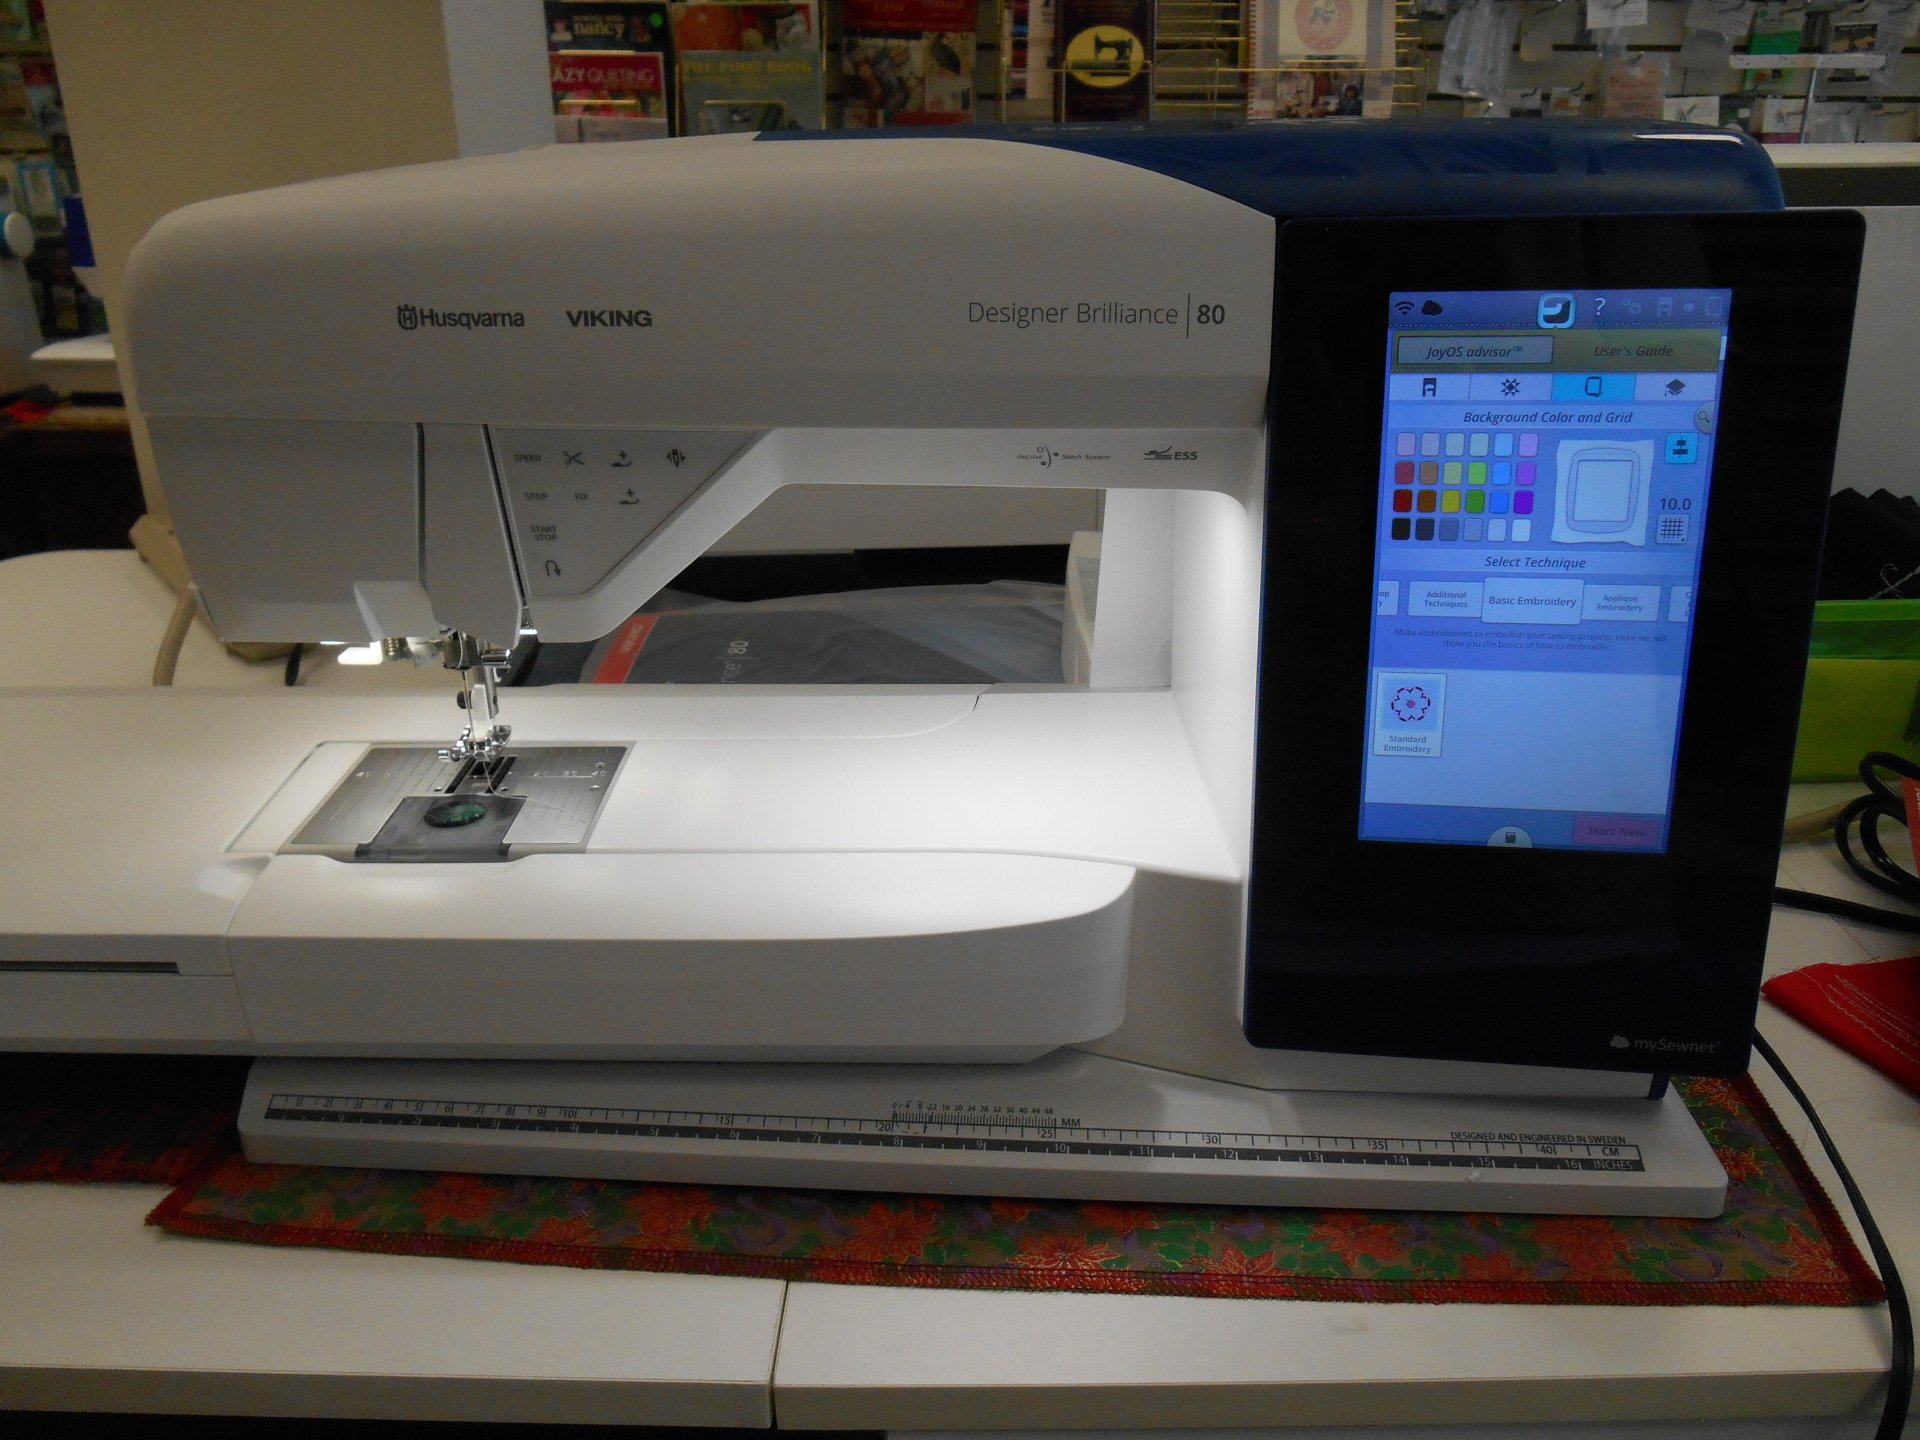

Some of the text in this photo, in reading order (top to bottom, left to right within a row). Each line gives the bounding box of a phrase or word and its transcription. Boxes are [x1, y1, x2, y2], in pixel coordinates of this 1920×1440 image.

[419, 308, 652, 330] Husqvarna VIKING
[968, 302, 1226, 329] Designer Brilliance 80
[1425, 346, 1463, 360] JoyOS
[1635, 345, 1673, 358] Guide
[1463, 412, 1633, 425] Background Color and Grid
[513, 454, 542, 463] SPEED
[1174, 451, 1198, 461] ESS
[1660, 497, 1692, 511] 10.0
[1485, 556, 1586, 571] Select Technique
[1424, 600, 1468, 608] Techniques
[1488, 596, 1577, 608] Basic Embroidery
[1602, 594, 1639, 602] Applique
[1596, 604, 1644, 613] Embroidery
[727, 640, 749, 655] 80
[1389, 735, 1427, 744] Standard
[1384, 744, 1432, 754] Embroidery
[1062, 1118, 1080, 1128] MM
[563, 1109, 574, 1118] 10
[719, 1116, 731, 1125] 15
[878, 1122, 891, 1132] 20
[1040, 1130, 1052, 1139] 25
[1205, 1134, 1218, 1144] 30
[1372, 1140, 1384, 1150] 35
[1540, 1146, 1553, 1154] 40
[1602, 1147, 1620, 1156] CM
[1450, 1132, 1626, 1144] DESIGNED AND ENGINEERED IN SWEDEN
[1055, 1144, 1066, 1152] 10
[1222, 1150, 1234, 1158] 12
[1308, 1152, 1319, 1161] 13
[1393, 1155, 1405, 1164] 14
[1479, 1158, 1491, 1166] 15
[1566, 1160, 1578, 1168] 16
[1593, 1160, 1633, 1170] INCHES
